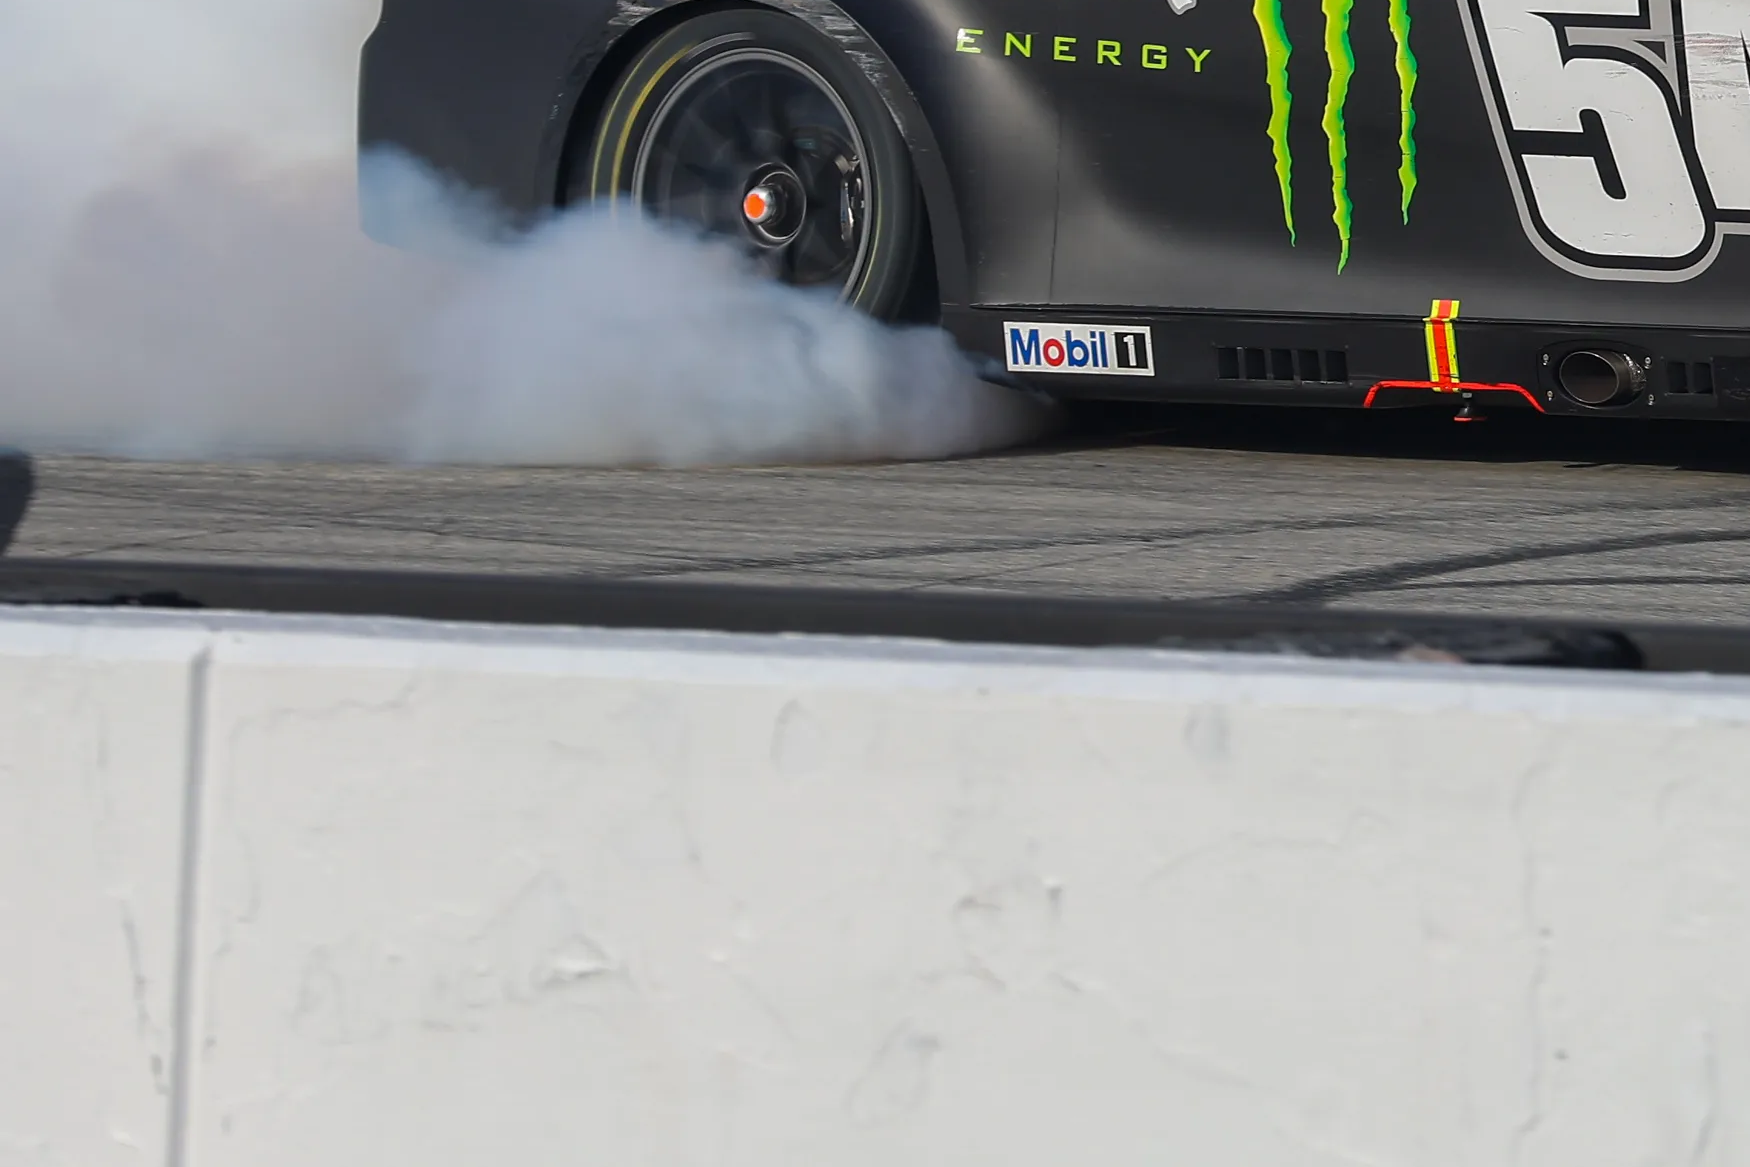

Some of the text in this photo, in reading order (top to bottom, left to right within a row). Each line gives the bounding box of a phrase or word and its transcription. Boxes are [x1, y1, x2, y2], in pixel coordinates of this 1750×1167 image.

[955, 27, 1212, 73] ENERGY
[1009, 327, 1137, 368] Mobil 1
